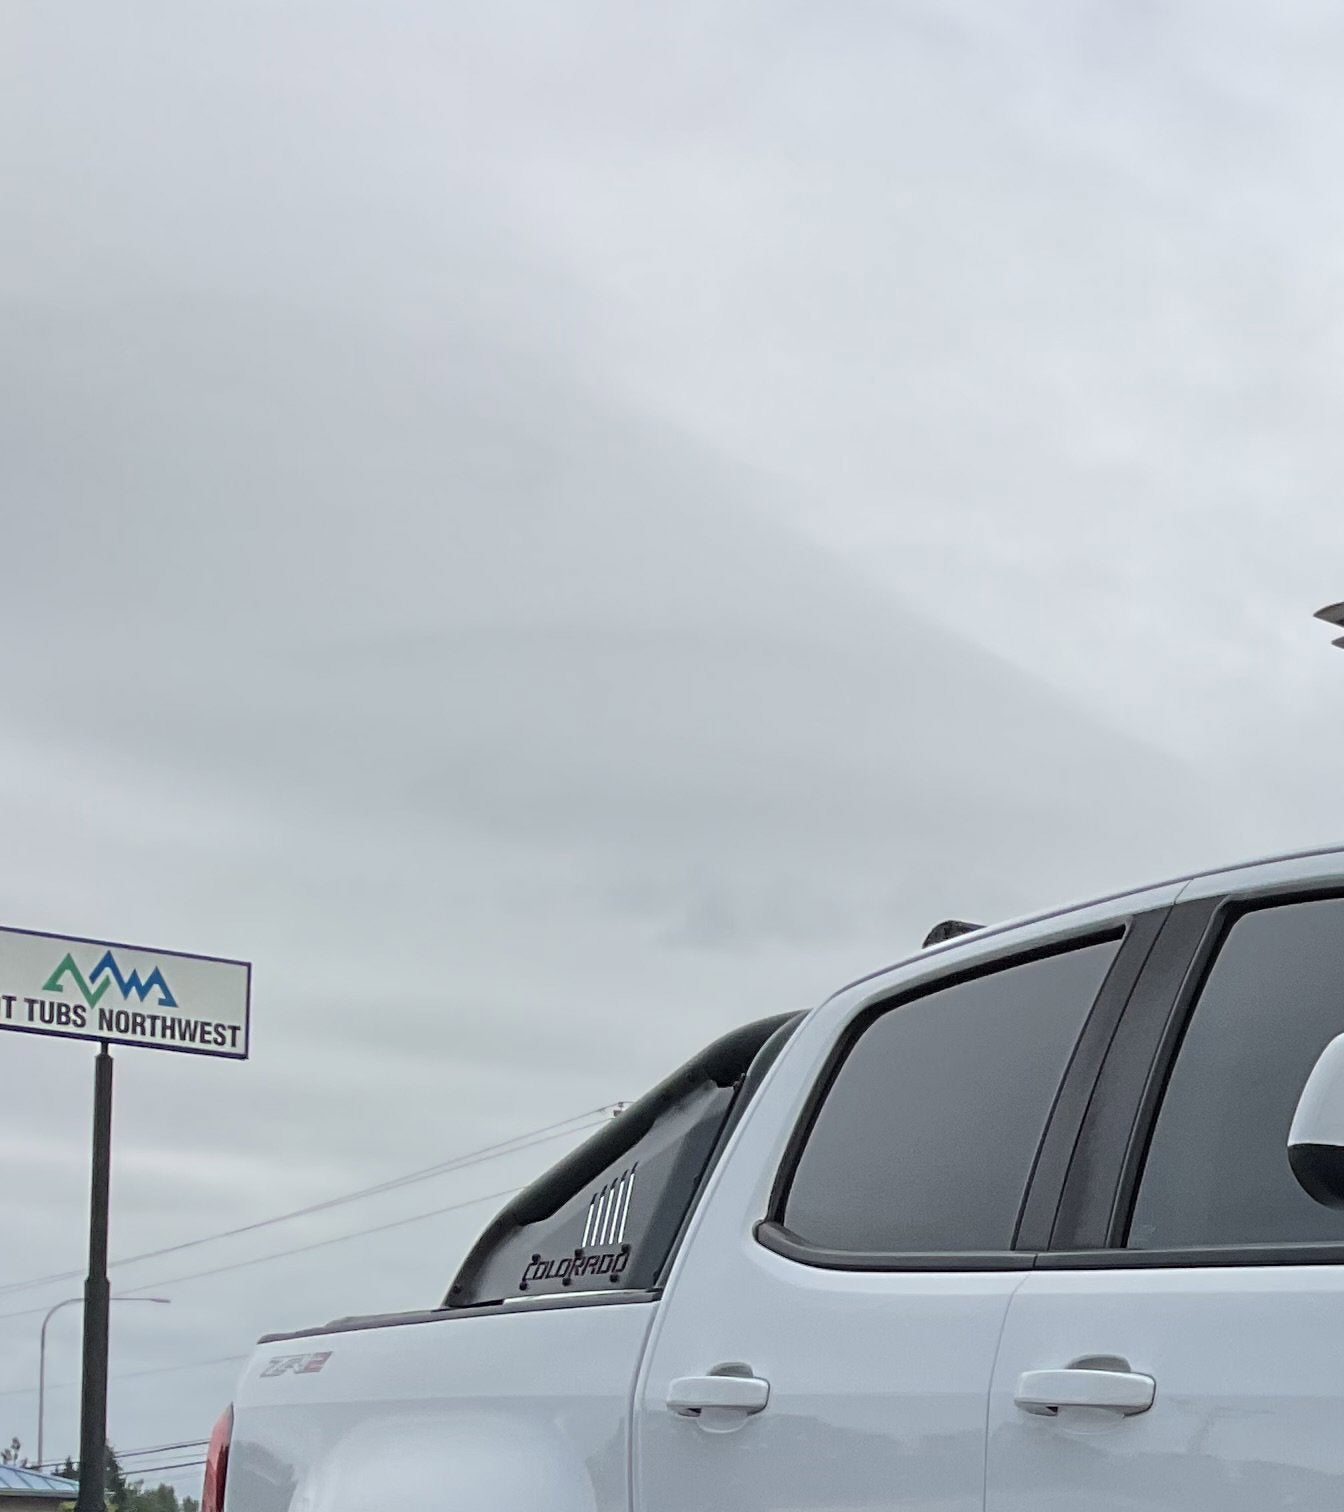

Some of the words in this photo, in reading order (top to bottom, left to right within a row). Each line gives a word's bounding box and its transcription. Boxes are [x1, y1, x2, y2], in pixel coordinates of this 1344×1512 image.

[24, 997, 87, 1028] TUBS
[98, 1007, 242, 1048] NORTHWEST
[520, 1251, 631, 1282] COLORADO
